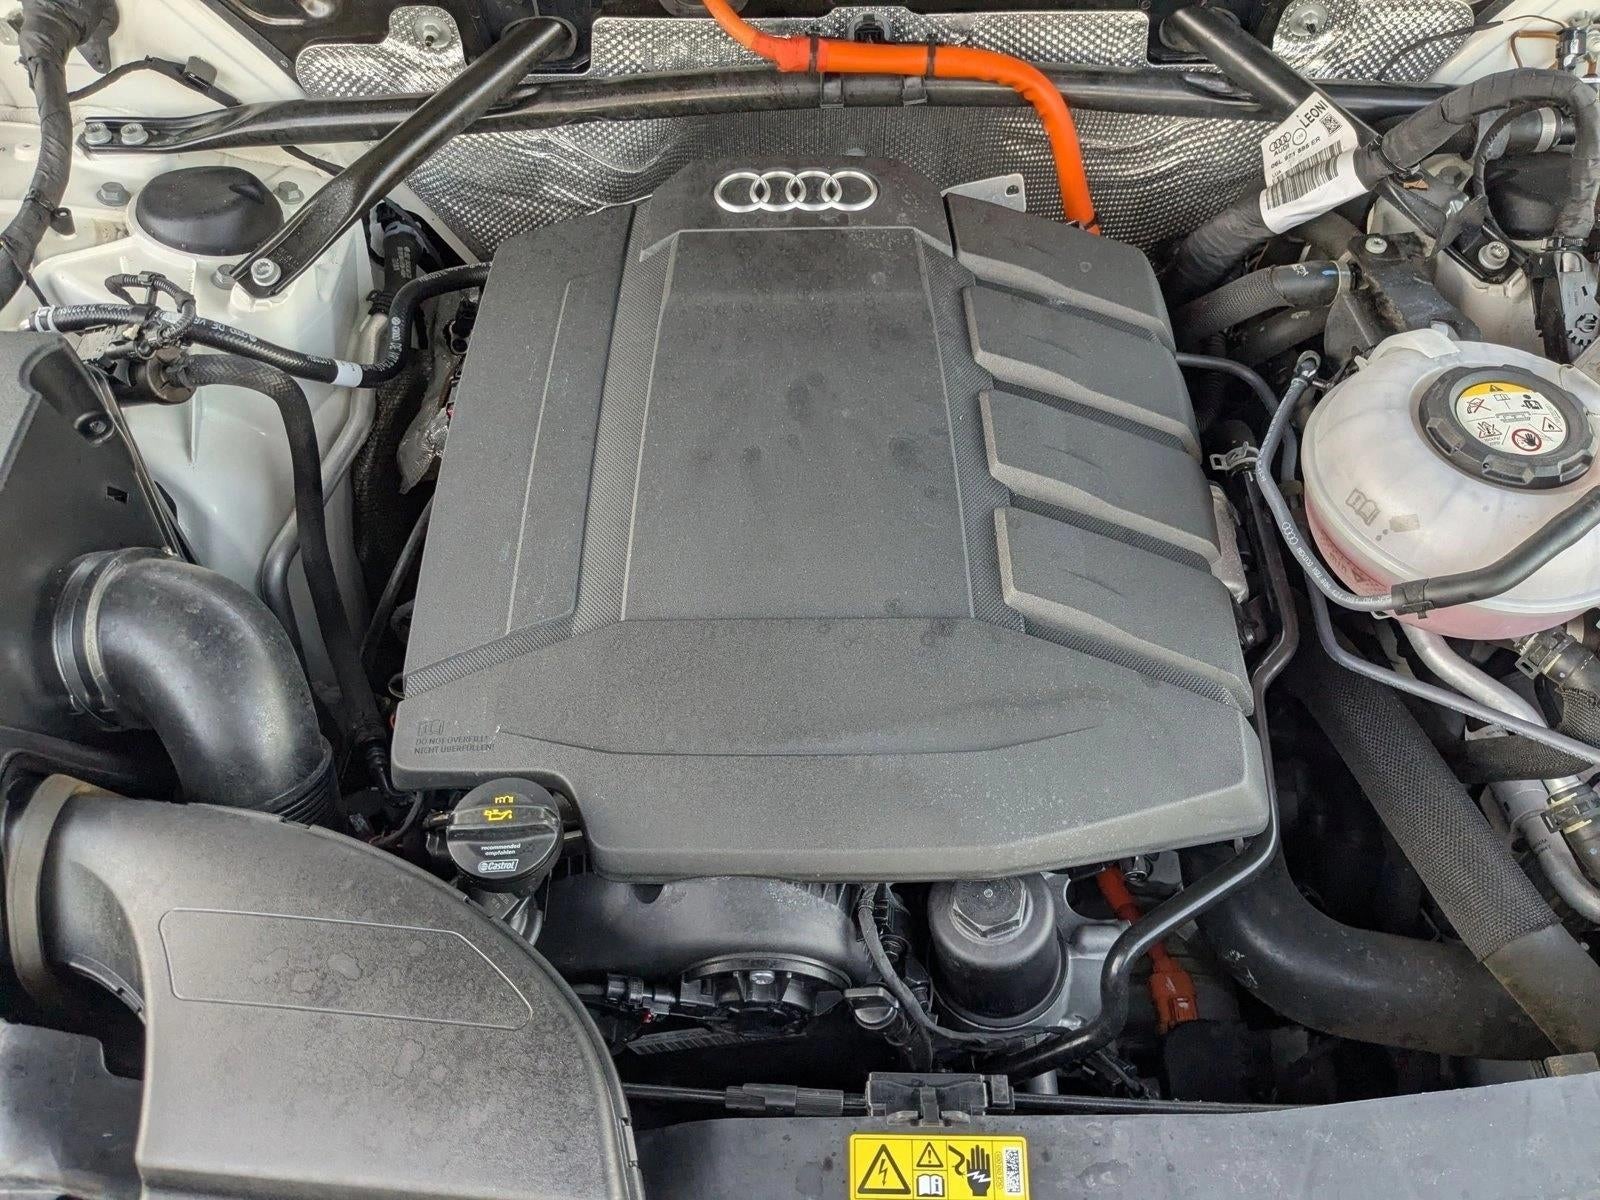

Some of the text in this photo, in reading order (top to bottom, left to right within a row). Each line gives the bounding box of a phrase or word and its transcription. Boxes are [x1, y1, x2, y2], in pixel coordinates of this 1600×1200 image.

[1300, 100, 1329, 129] LEONI
[1273, 143, 1290, 157] AUDI
[414, 745, 440, 755] NICHT
[480, 843, 521, 851] recommended
[487, 860, 515, 871] Castrol
